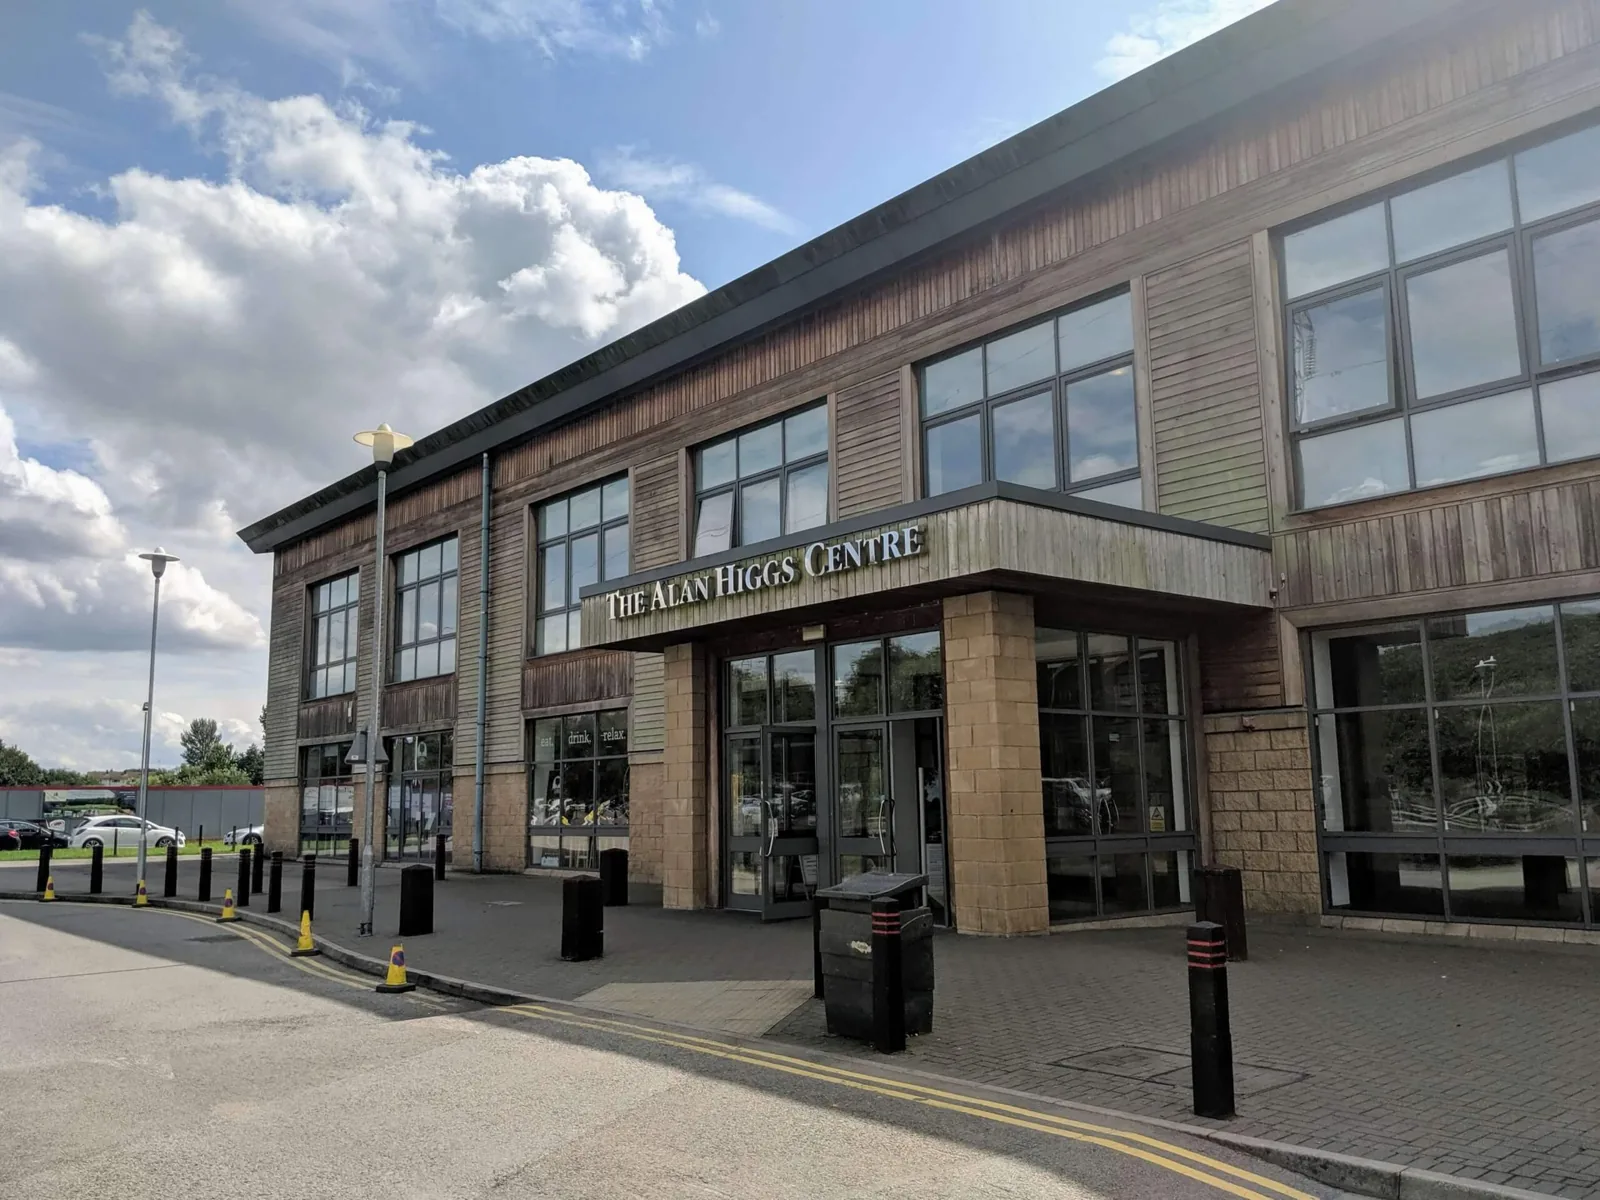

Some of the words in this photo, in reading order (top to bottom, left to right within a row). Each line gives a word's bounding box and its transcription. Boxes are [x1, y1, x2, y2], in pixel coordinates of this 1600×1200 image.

[606, 590, 645, 620] THE
[650, 575, 709, 611] ALAN
[714, 556, 796, 597] HIGGS
[804, 525, 923, 577] CENTRE
